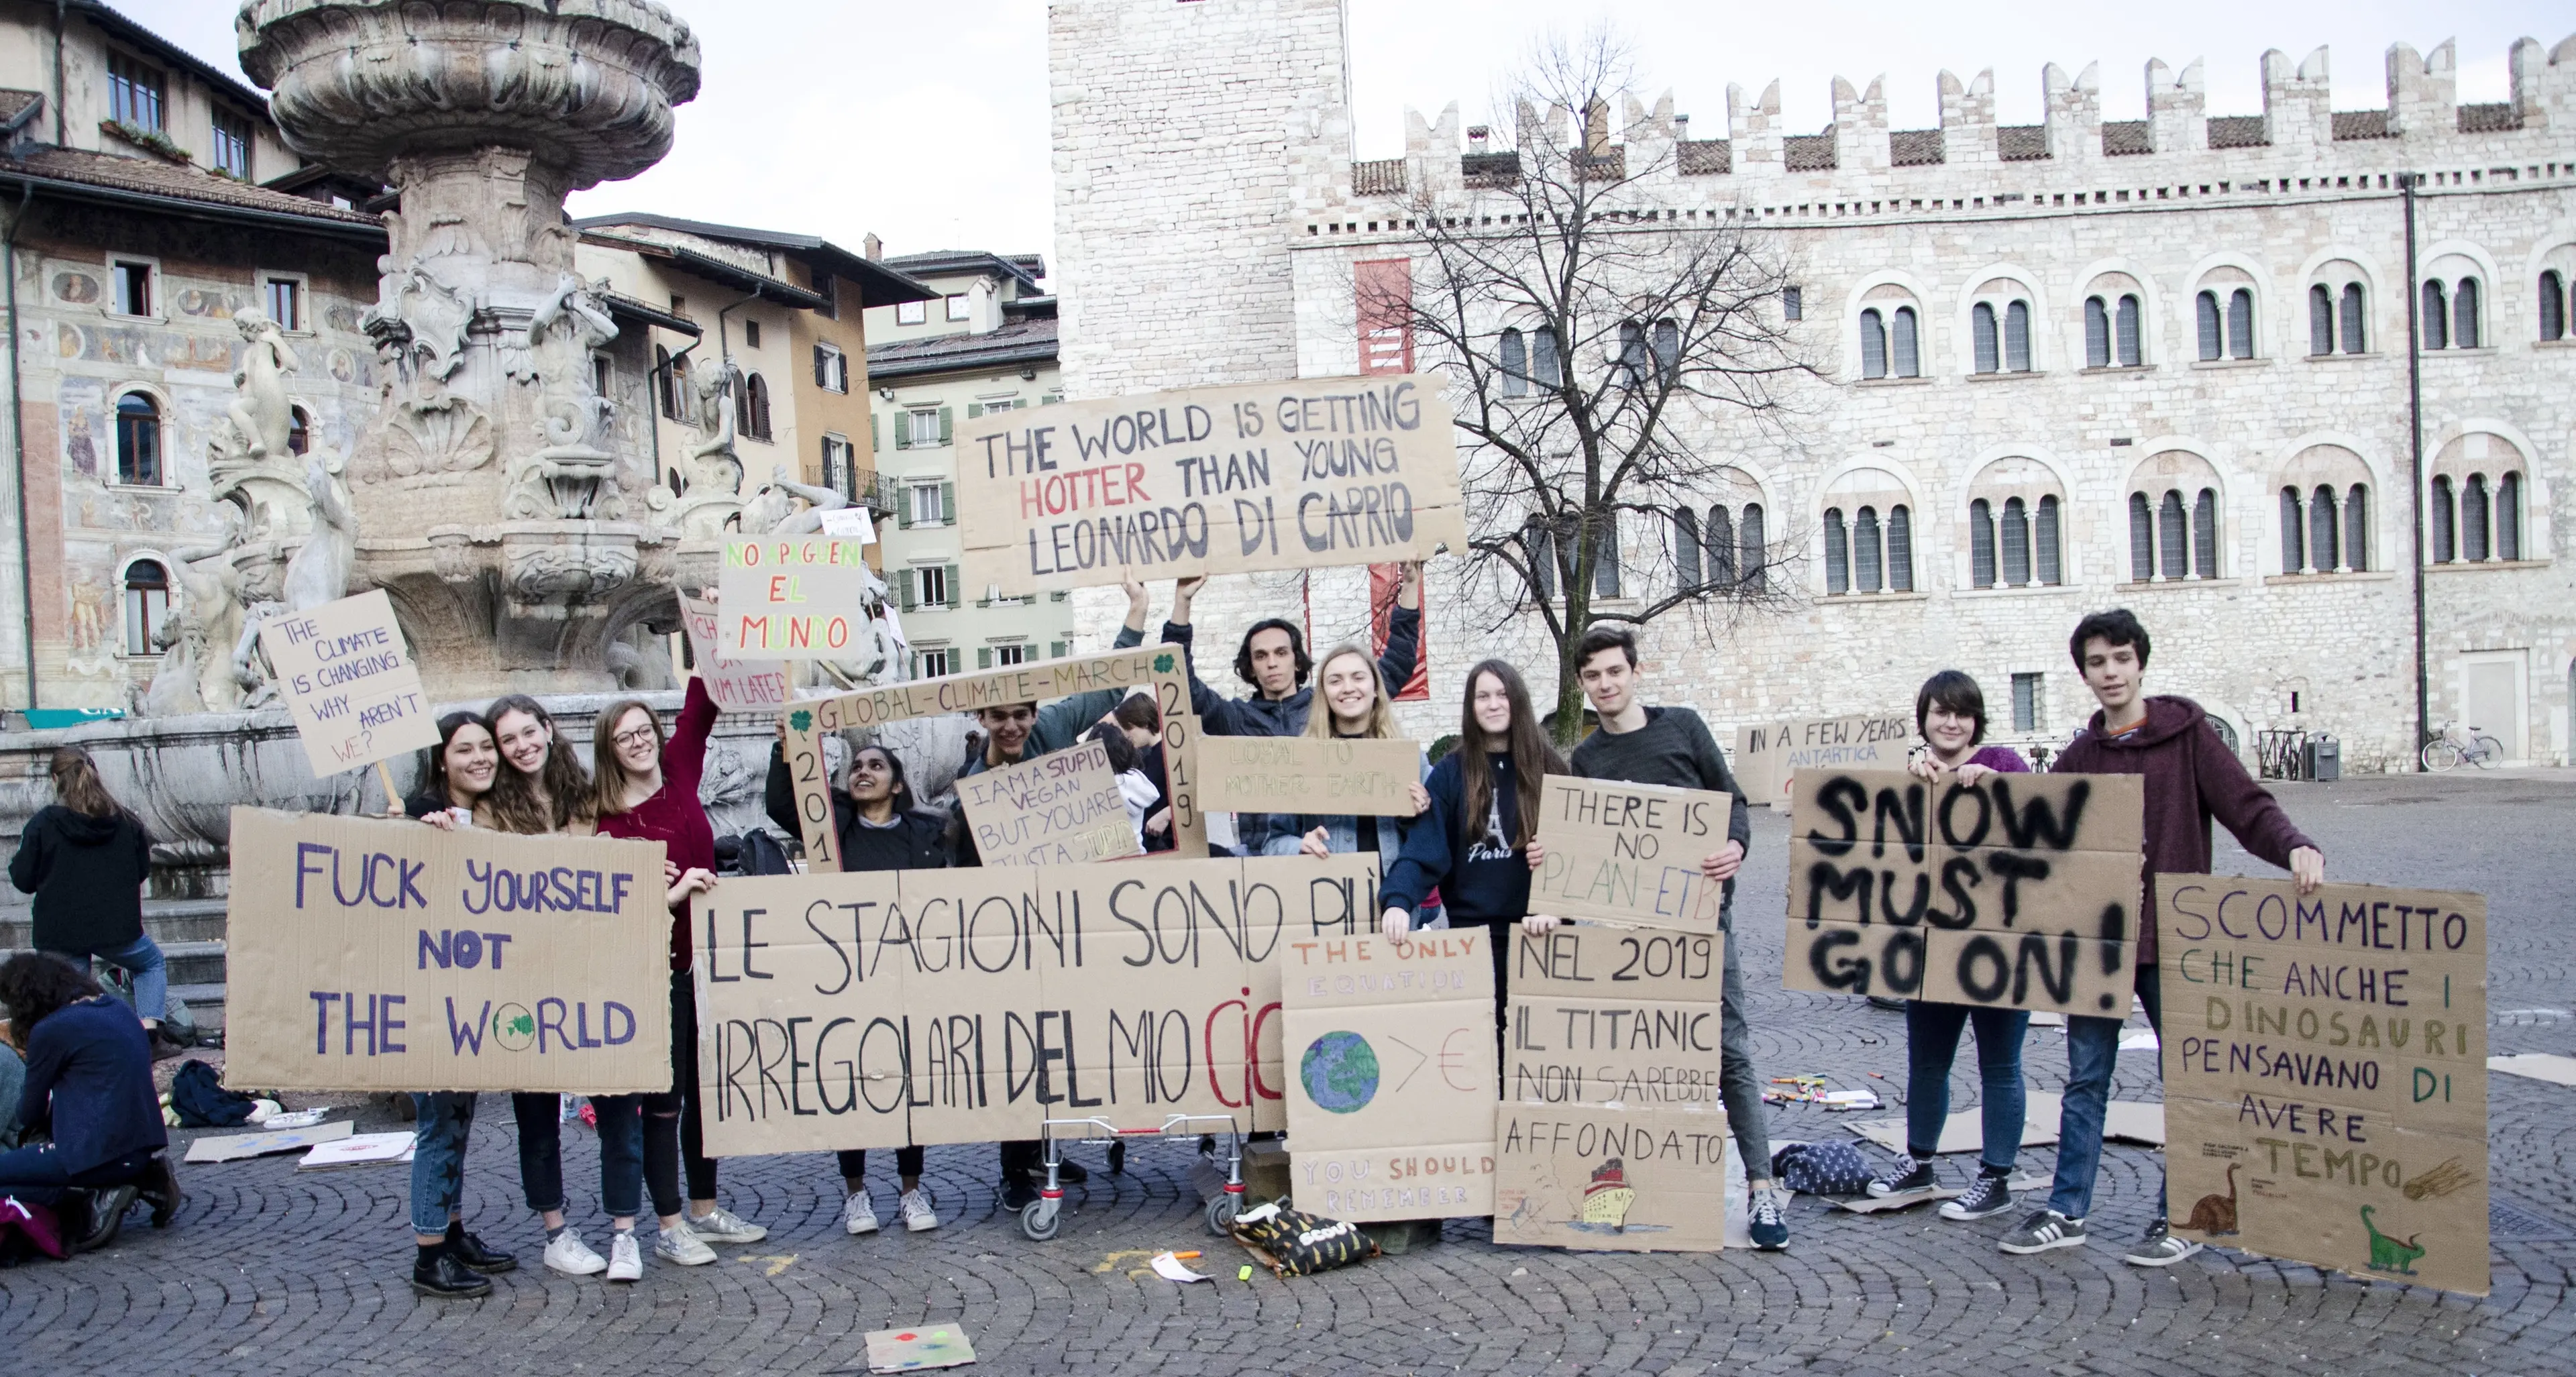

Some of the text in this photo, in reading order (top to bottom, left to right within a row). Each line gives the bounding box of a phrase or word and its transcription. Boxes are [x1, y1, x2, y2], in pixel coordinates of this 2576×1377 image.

[975, 381, 1420, 478] THE WORLD IS GETTING
[1020, 437, 1399, 520] HOTTER THAN YOUNG
[1029, 480, 1413, 576] LEONARDO DI CAPRIO
[726, 541, 861, 569] NO APAGUEN
[769, 574, 807, 603] EL
[272, 617, 320, 645] THE
[315, 626, 390, 662] CLIMATE
[739, 614, 849, 651] MUNDO
[291, 651, 399, 695] IS CHANGING
[310, 692, 418, 730] WHY AREN'T
[331, 730, 372, 763] WE?
[1162, 681, 1192, 828] 2019
[1230, 739, 1354, 765] LOYAL TO
[1750, 718, 1907, 753] IN A FEW YEARS
[1786, 745, 1879, 767] ANTARTICA
[969, 747, 1106, 806] I AM A STUPID
[1011, 778, 1081, 810] VEGAN
[1225, 771, 1401, 798] MOTHER EARTH
[796, 751, 832, 863] 201
[1556, 787, 1710, 836] THERE IS
[1806, 775, 2092, 863] SNOW
[978, 816, 1031, 850] BUT
[1057, 843, 1073, 865] A
[1467, 840, 1513, 863] Paris
[1614, 832, 1659, 860] NO
[295, 841, 634, 915] FUCK YOURSELF
[1806, 850, 2051, 930] MUST
[707, 908, 773, 983] LE
[805, 889, 1082, 995] STAGIONI
[1109, 879, 1283, 969] SONO
[2172, 884, 2467, 950] SCOMMETTO
[418, 929, 512, 970] NOT
[1291, 936, 1476, 965] THE ONLY
[1519, 932, 1711, 981] NEL 2019
[1810, 928, 1924, 995] GO
[1307, 969, 1466, 997] EQUATION
[2180, 948, 2451, 1009] CHE ANCHE I
[309, 991, 637, 1057] THE WORLD
[1515, 1005, 1713, 1052] IL TITANIC
[2206, 995, 2468, 1056] DINOSAURI
[716, 1013, 987, 1122] IRREGOLARI
[1005, 1009, 1102, 1107] DEL
[1110, 1008, 1191, 1104] MIO
[1517, 1062, 1718, 1103] NON SAREBBE
[2182, 1036, 2451, 1103] PENSAVANO DI
[2238, 1093, 2367, 1143] AVERE
[1505, 1117, 1723, 1165] AFFONDATO
[2255, 1136, 2401, 1189] TEMPO
[1302, 1156, 1495, 1185] YOU SHOULD
[1326, 1185, 1468, 1213] REMEMBER
